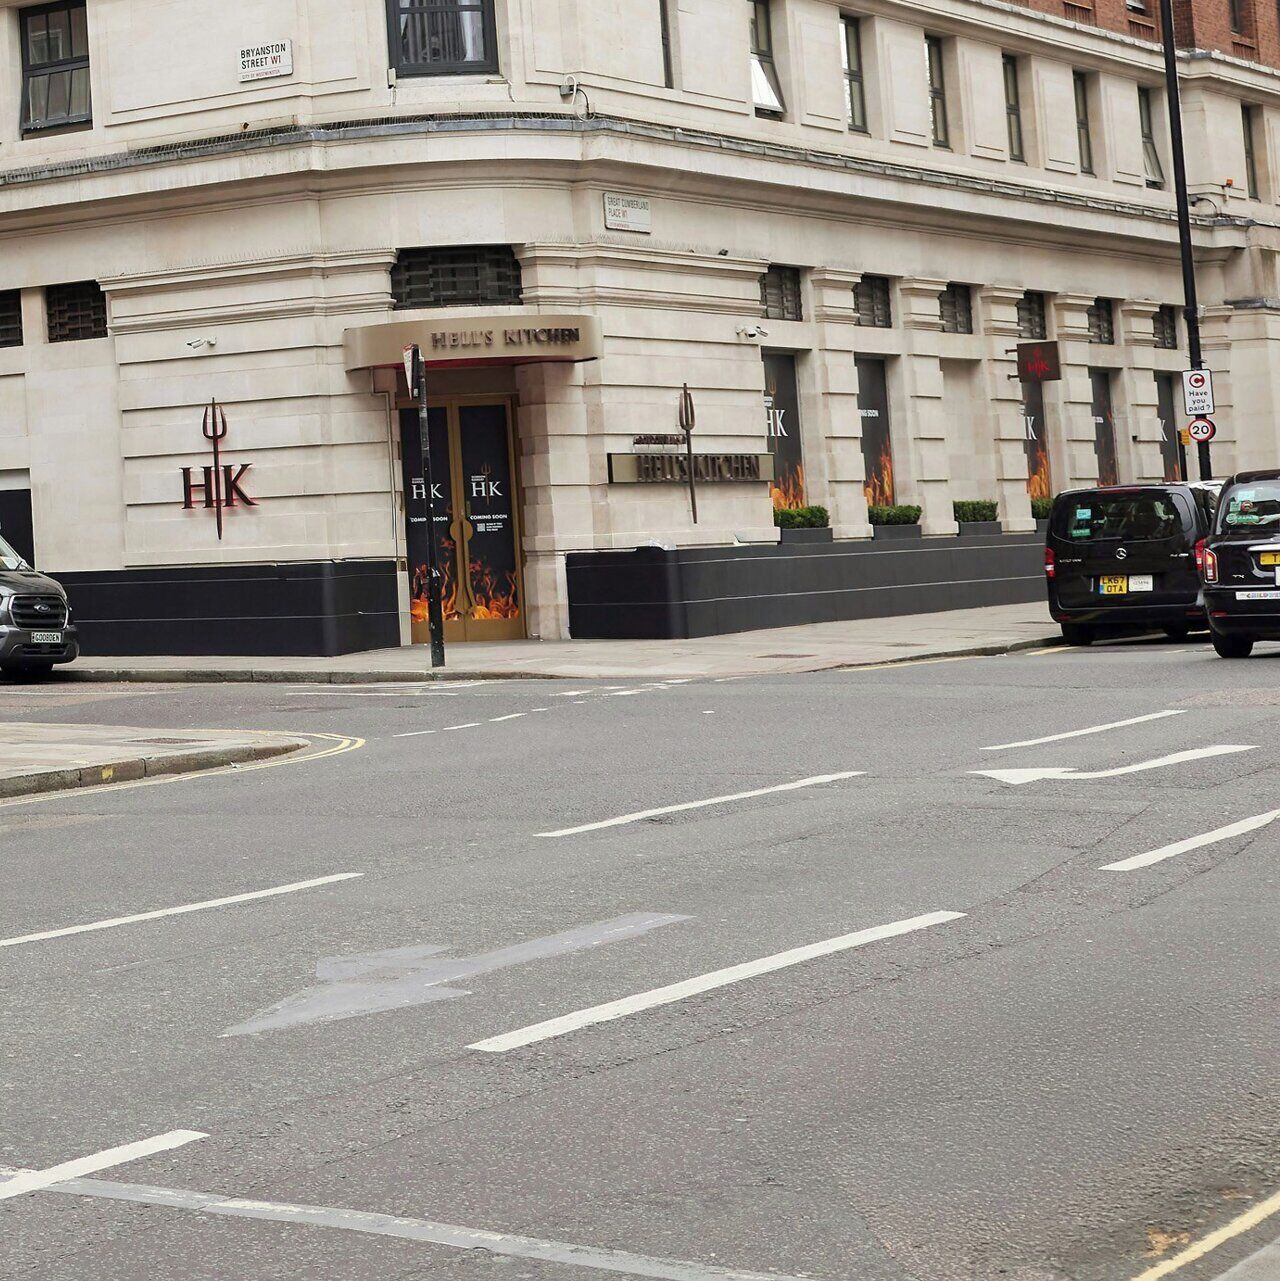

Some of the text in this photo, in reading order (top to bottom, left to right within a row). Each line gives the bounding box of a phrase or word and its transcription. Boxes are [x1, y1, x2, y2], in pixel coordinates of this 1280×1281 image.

[241, 44, 286, 58] BRYANSTON
[242, 55, 280, 69] STREET W1
[431, 328, 579, 348] HELL'S KITCHEN
[1192, 426, 1209, 434] 20
[179, 463, 260, 509] HK
[411, 483, 443, 499] HK
[472, 481, 503, 497] HK
[1102, 576, 1125, 584] LK67
